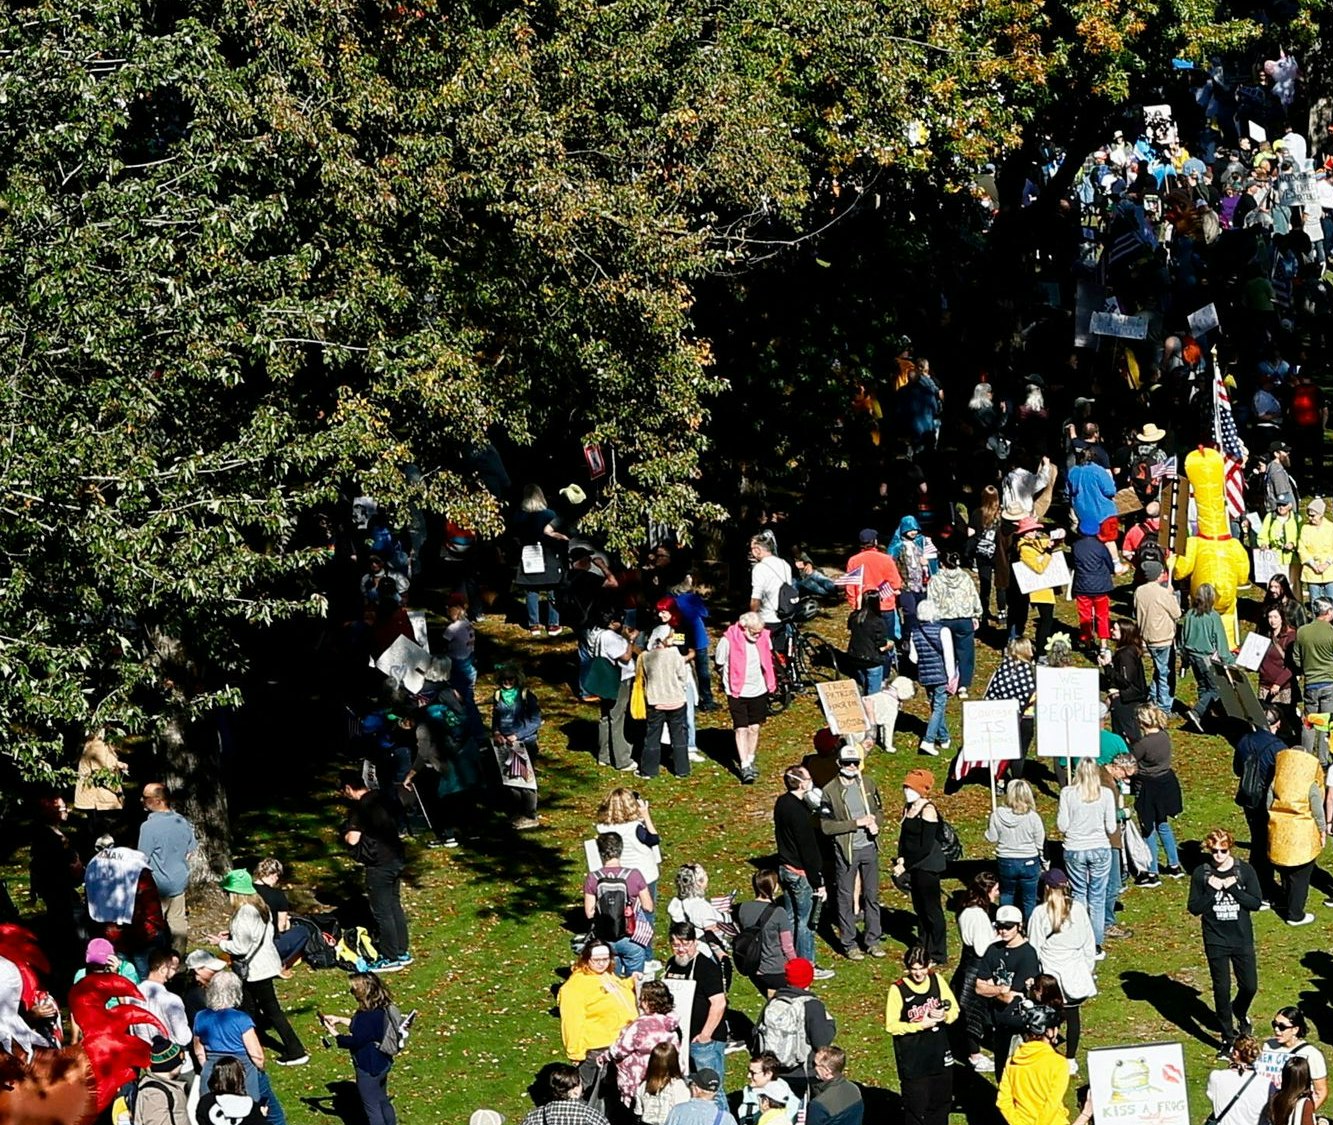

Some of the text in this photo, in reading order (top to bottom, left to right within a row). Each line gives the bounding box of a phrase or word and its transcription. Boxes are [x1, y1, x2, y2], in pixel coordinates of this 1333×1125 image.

[1057, 671, 1082, 685] WE
[1055, 687, 1083, 701] THE
[1040, 703, 1099, 723] PEOPLE
[1103, 1102, 1136, 1118] KISS
